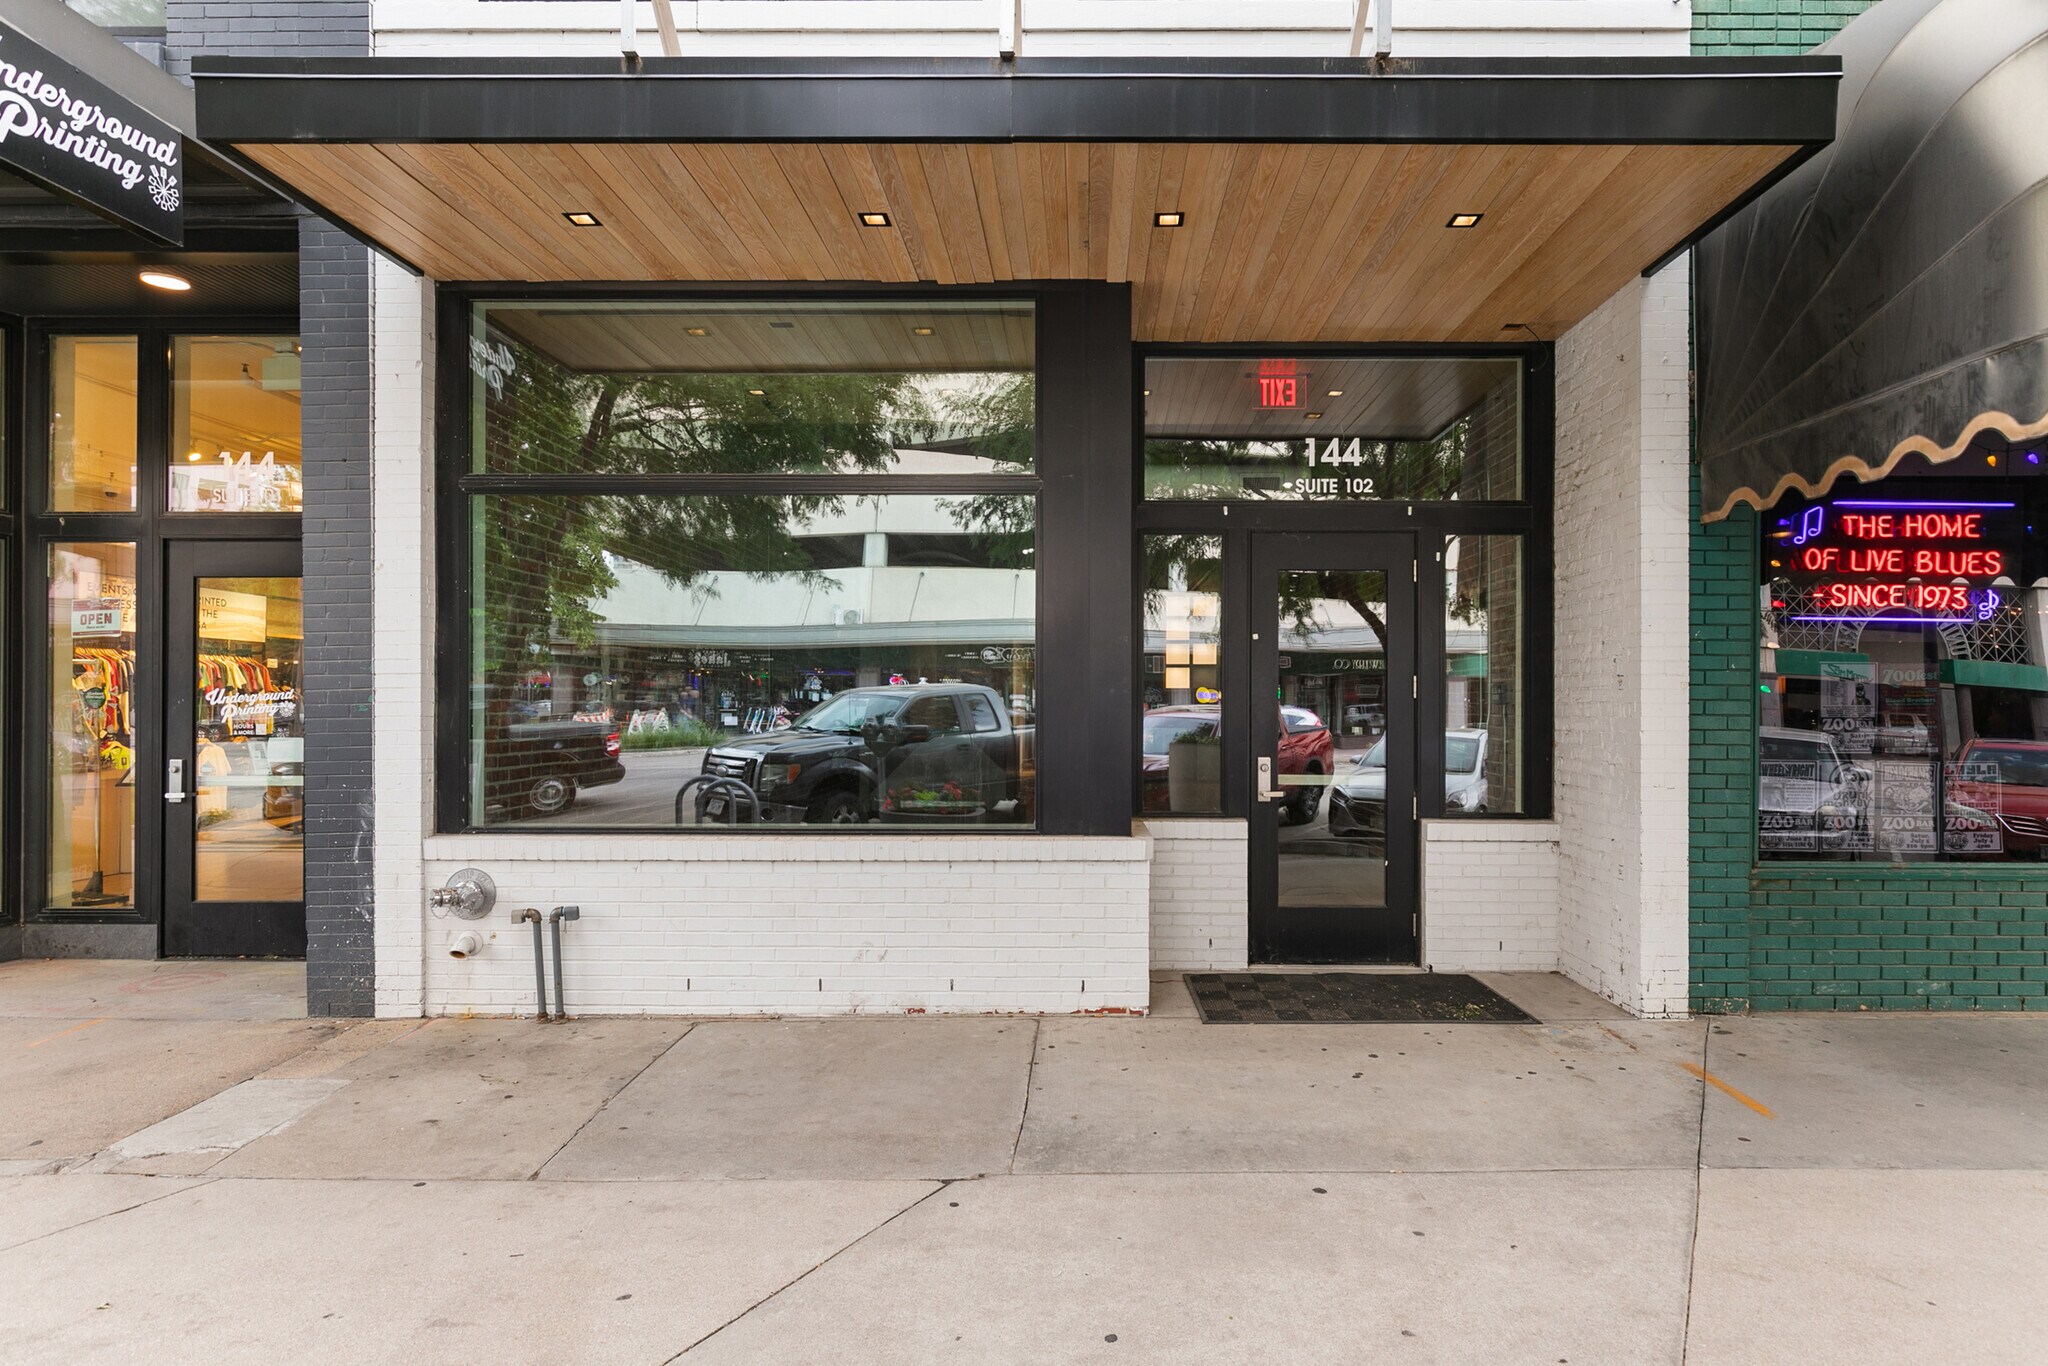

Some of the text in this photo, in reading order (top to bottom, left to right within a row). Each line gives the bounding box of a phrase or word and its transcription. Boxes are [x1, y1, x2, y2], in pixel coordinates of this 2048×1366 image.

[0, 58, 178, 167] nderground
[1304, 437, 1363, 467] 144
[218, 451, 275, 480] 144
[1295, 478, 1374, 494] SUITE 102
[1842, 514, 1982, 538] THE HOME
[1804, 547, 2002, 575] OF LIVE BLUES
[199, 597, 227, 608] INTED
[1917, 584, 1968, 610] 1973
[80, 612, 113, 626] OPEN
[202, 609, 218, 619] THE
[205, 688, 295, 706] Underground
[1822, 718, 1855, 731] ZOO
[1762, 815, 1814, 828] ZOO BAR
[1823, 816, 1856, 829] ZOO
[1882, 817, 1935, 830] ZOO BAR
[1945, 817, 1979, 830] ZOO
[1972, 832, 1994, 840] Friday
